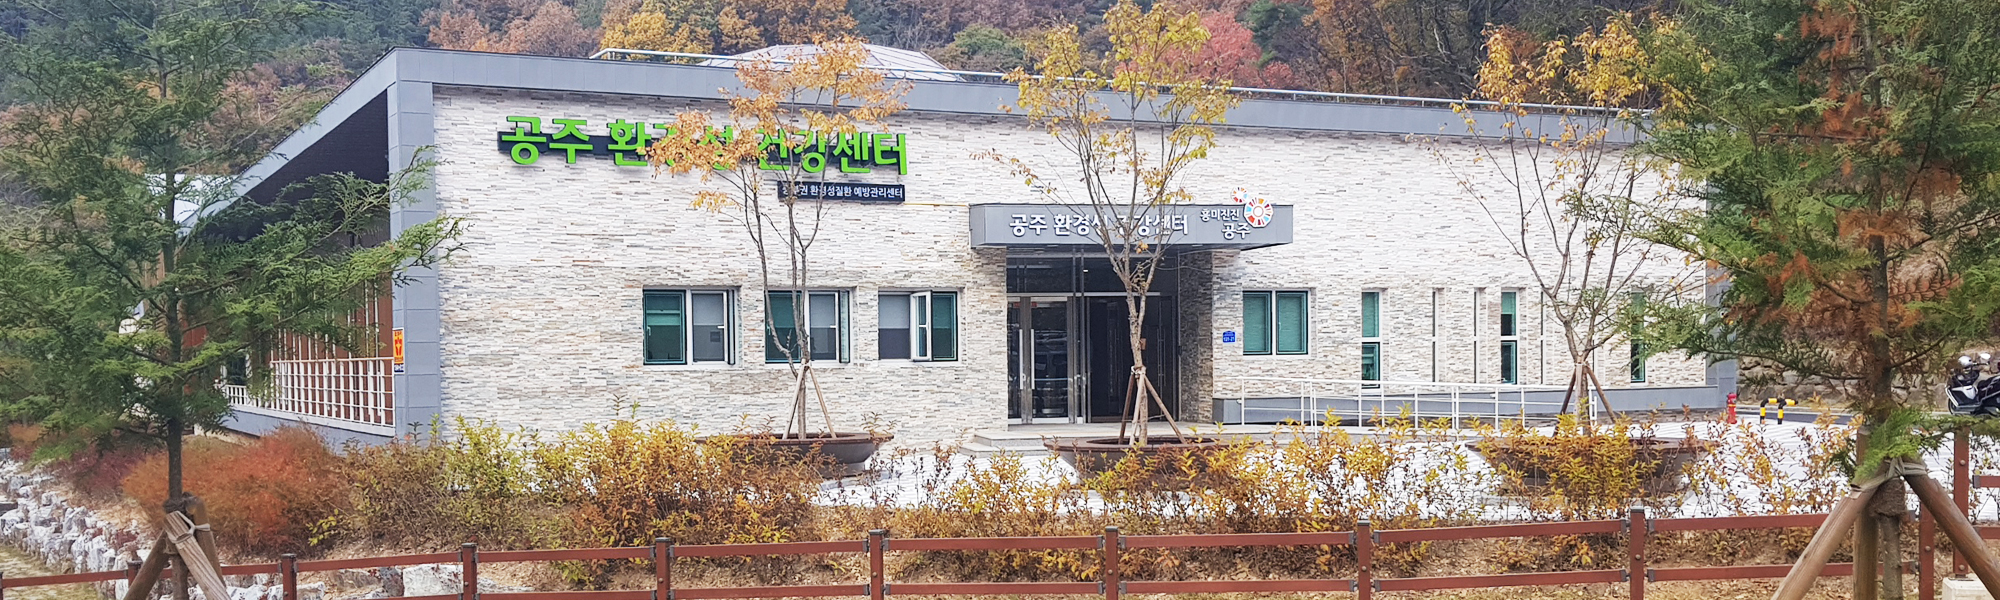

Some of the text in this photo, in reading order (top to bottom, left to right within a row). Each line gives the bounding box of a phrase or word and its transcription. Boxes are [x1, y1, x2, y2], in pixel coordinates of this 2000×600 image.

[501, 116, 593, 165] 공주
[757, 128, 908, 175] 건강센터
[853, 187, 903, 198] 예방관리센터
[1200, 208, 1240, 222] 흥미진진
[1009, 214, 1048, 237] 공주
[1222, 222, 1251, 240] 공주
